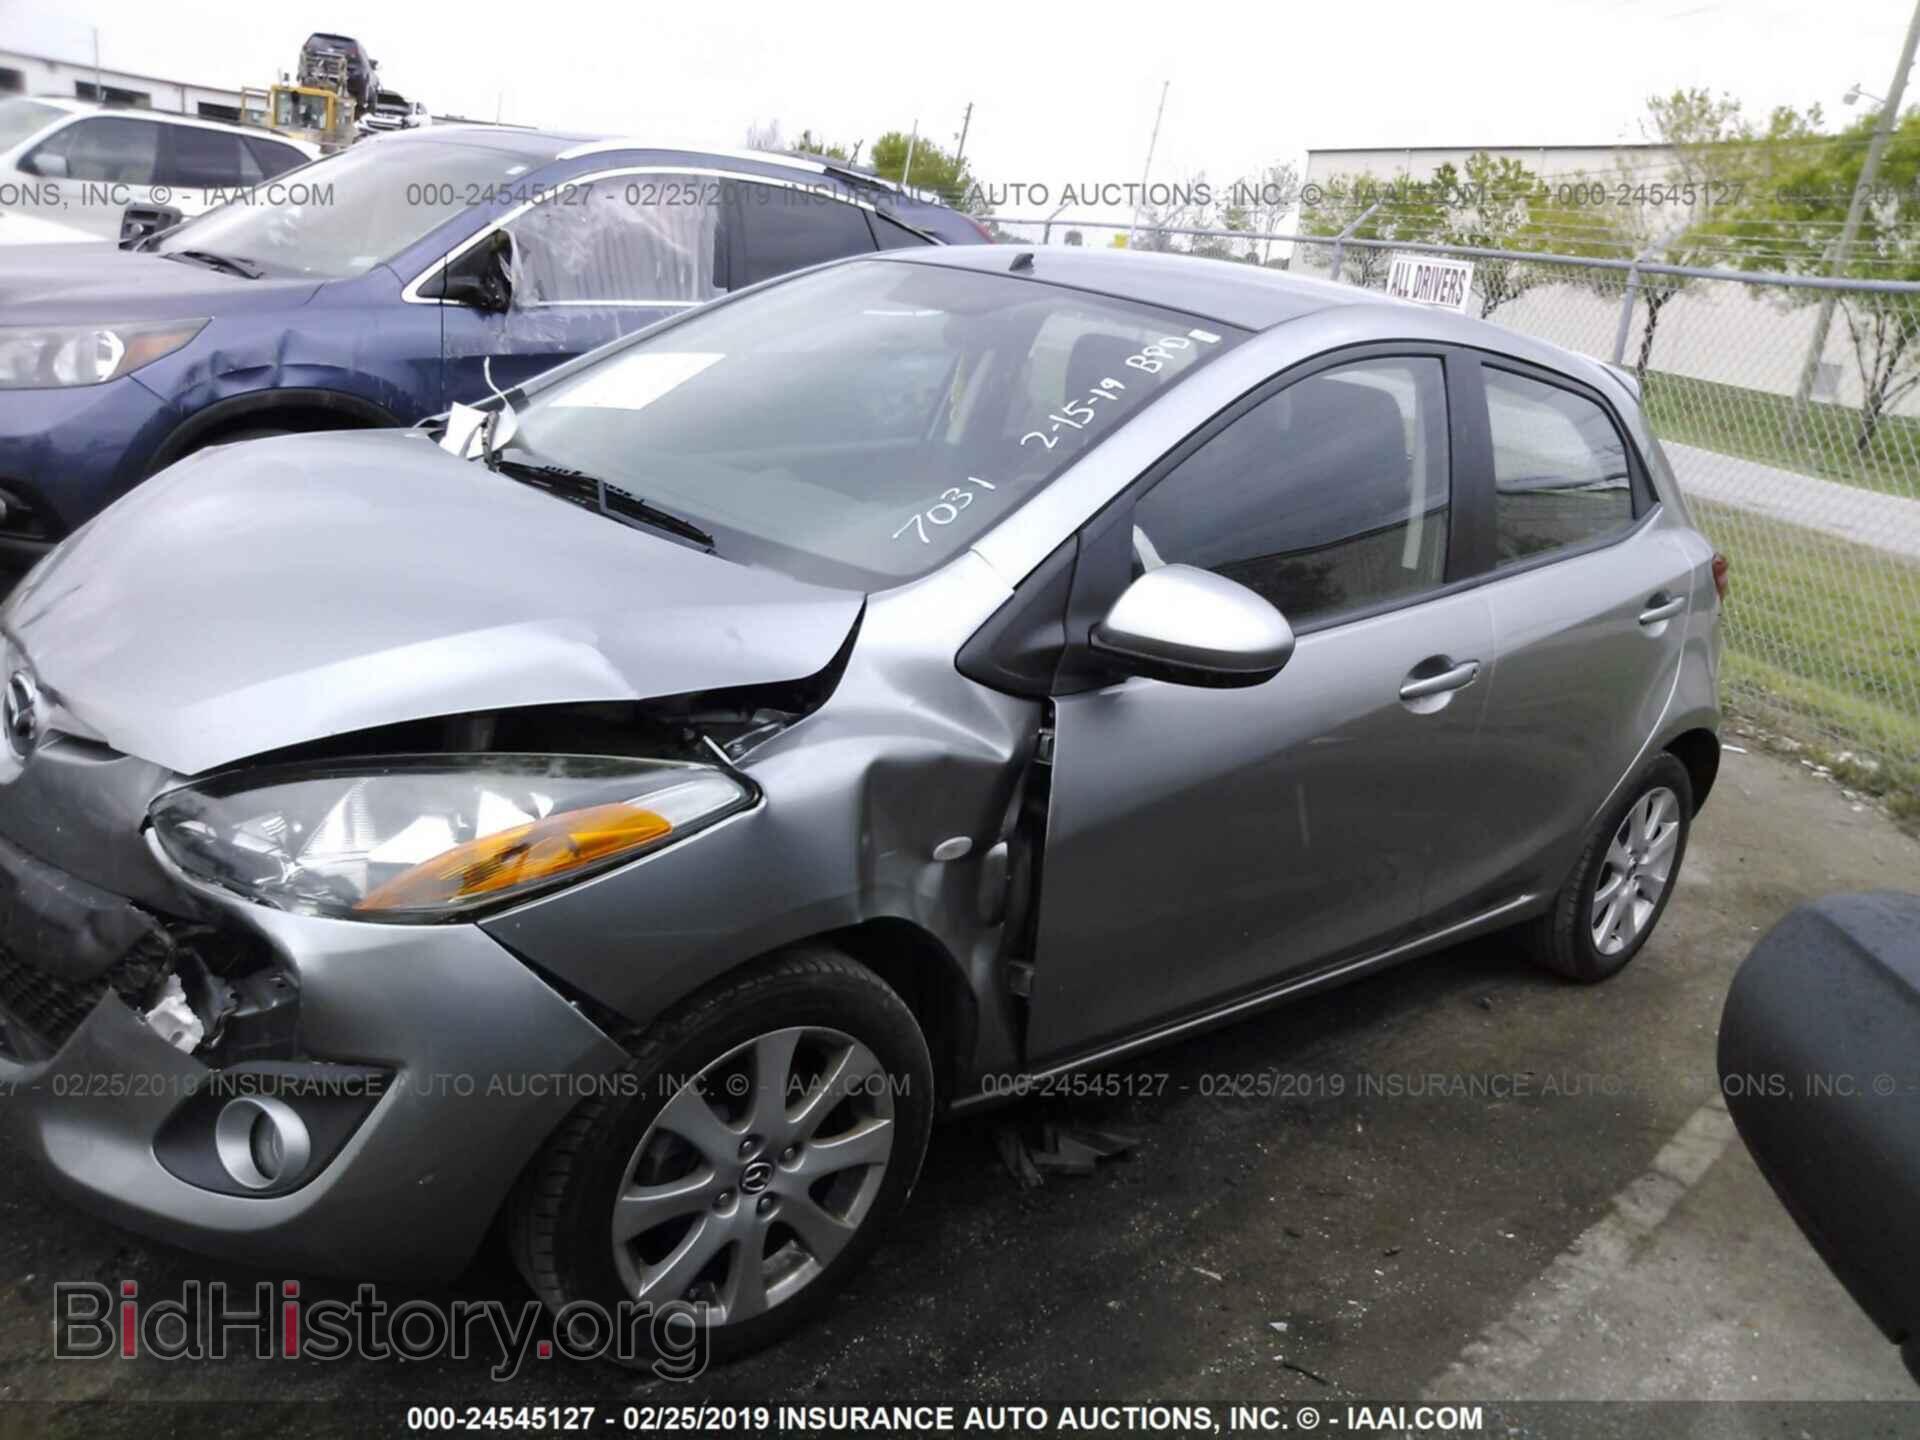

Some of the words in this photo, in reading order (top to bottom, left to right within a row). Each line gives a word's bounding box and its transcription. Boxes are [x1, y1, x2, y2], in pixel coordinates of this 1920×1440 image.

[1391, 262, 1411, 297] ALL
[1412, 264, 1466, 305] DRIVERS
[893, 477, 996, 543] 7031
[1020, 377, 1126, 449] 2-15-19
